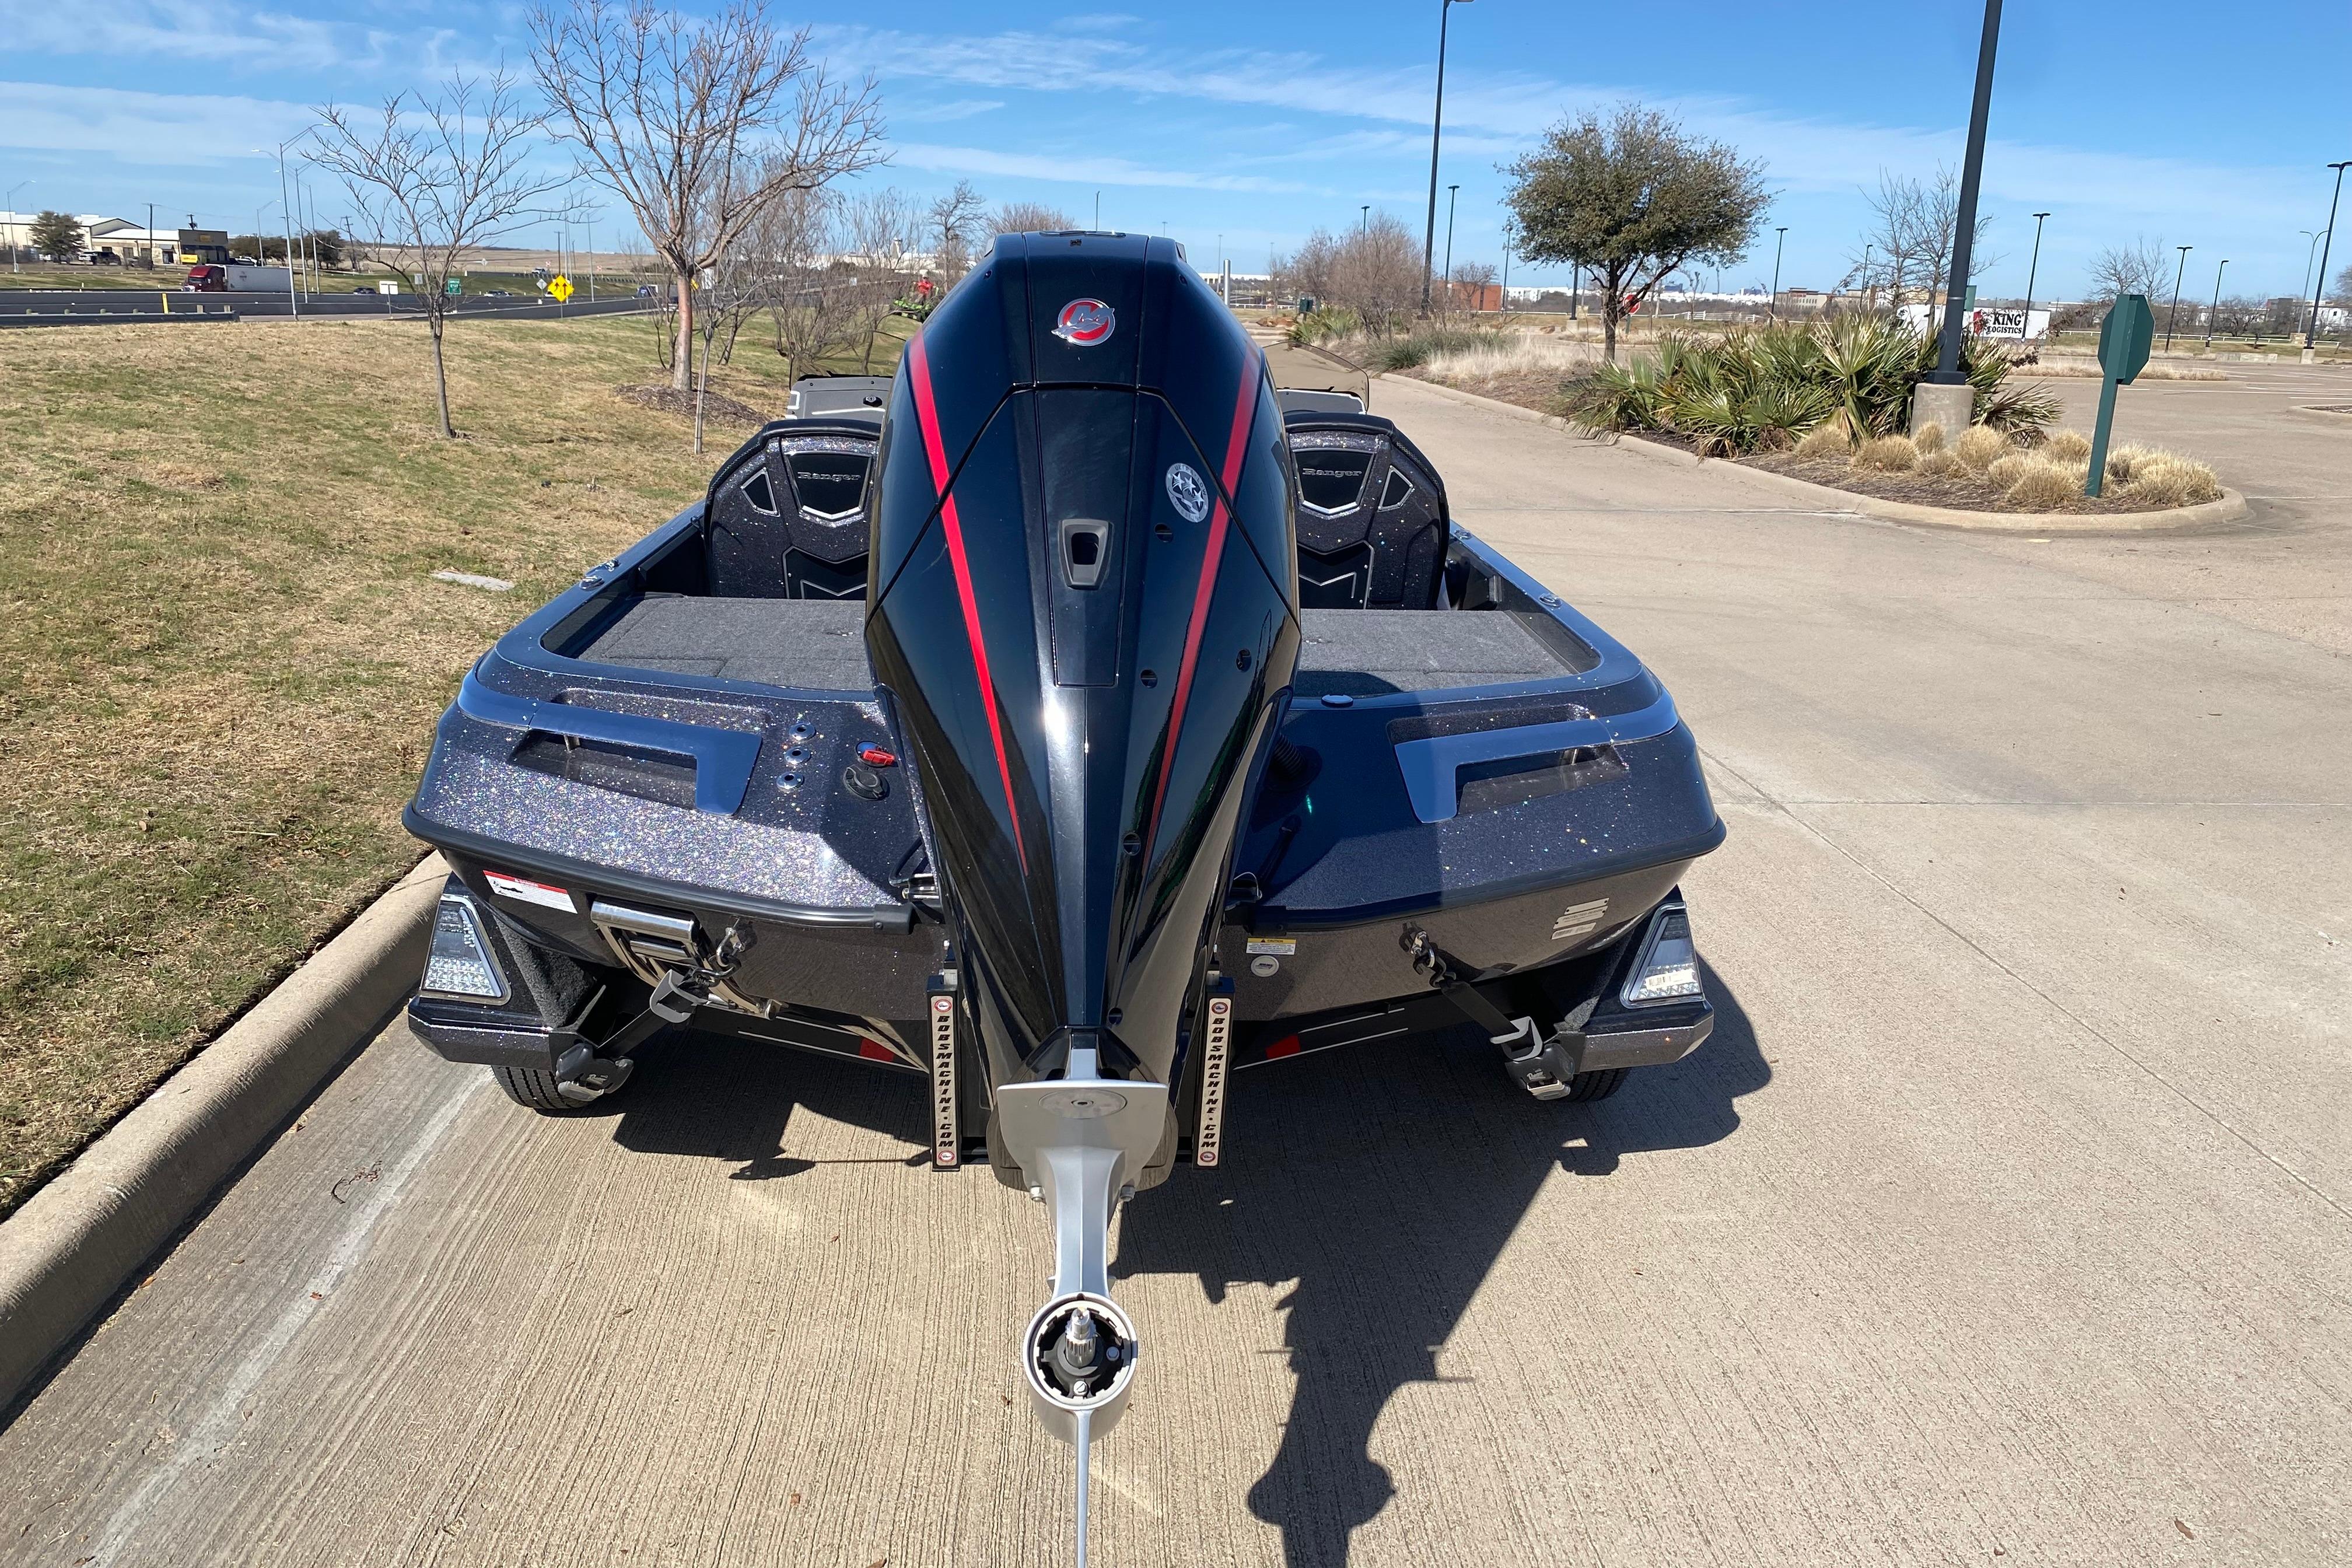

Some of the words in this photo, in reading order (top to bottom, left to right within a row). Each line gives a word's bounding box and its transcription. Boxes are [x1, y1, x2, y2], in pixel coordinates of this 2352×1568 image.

[1993, 313, 2021, 326] KING
[1986, 326, 2022, 335] LOGISTICS
[797, 471, 862, 482] Ranger
[1302, 468, 1362, 478] Ranger
